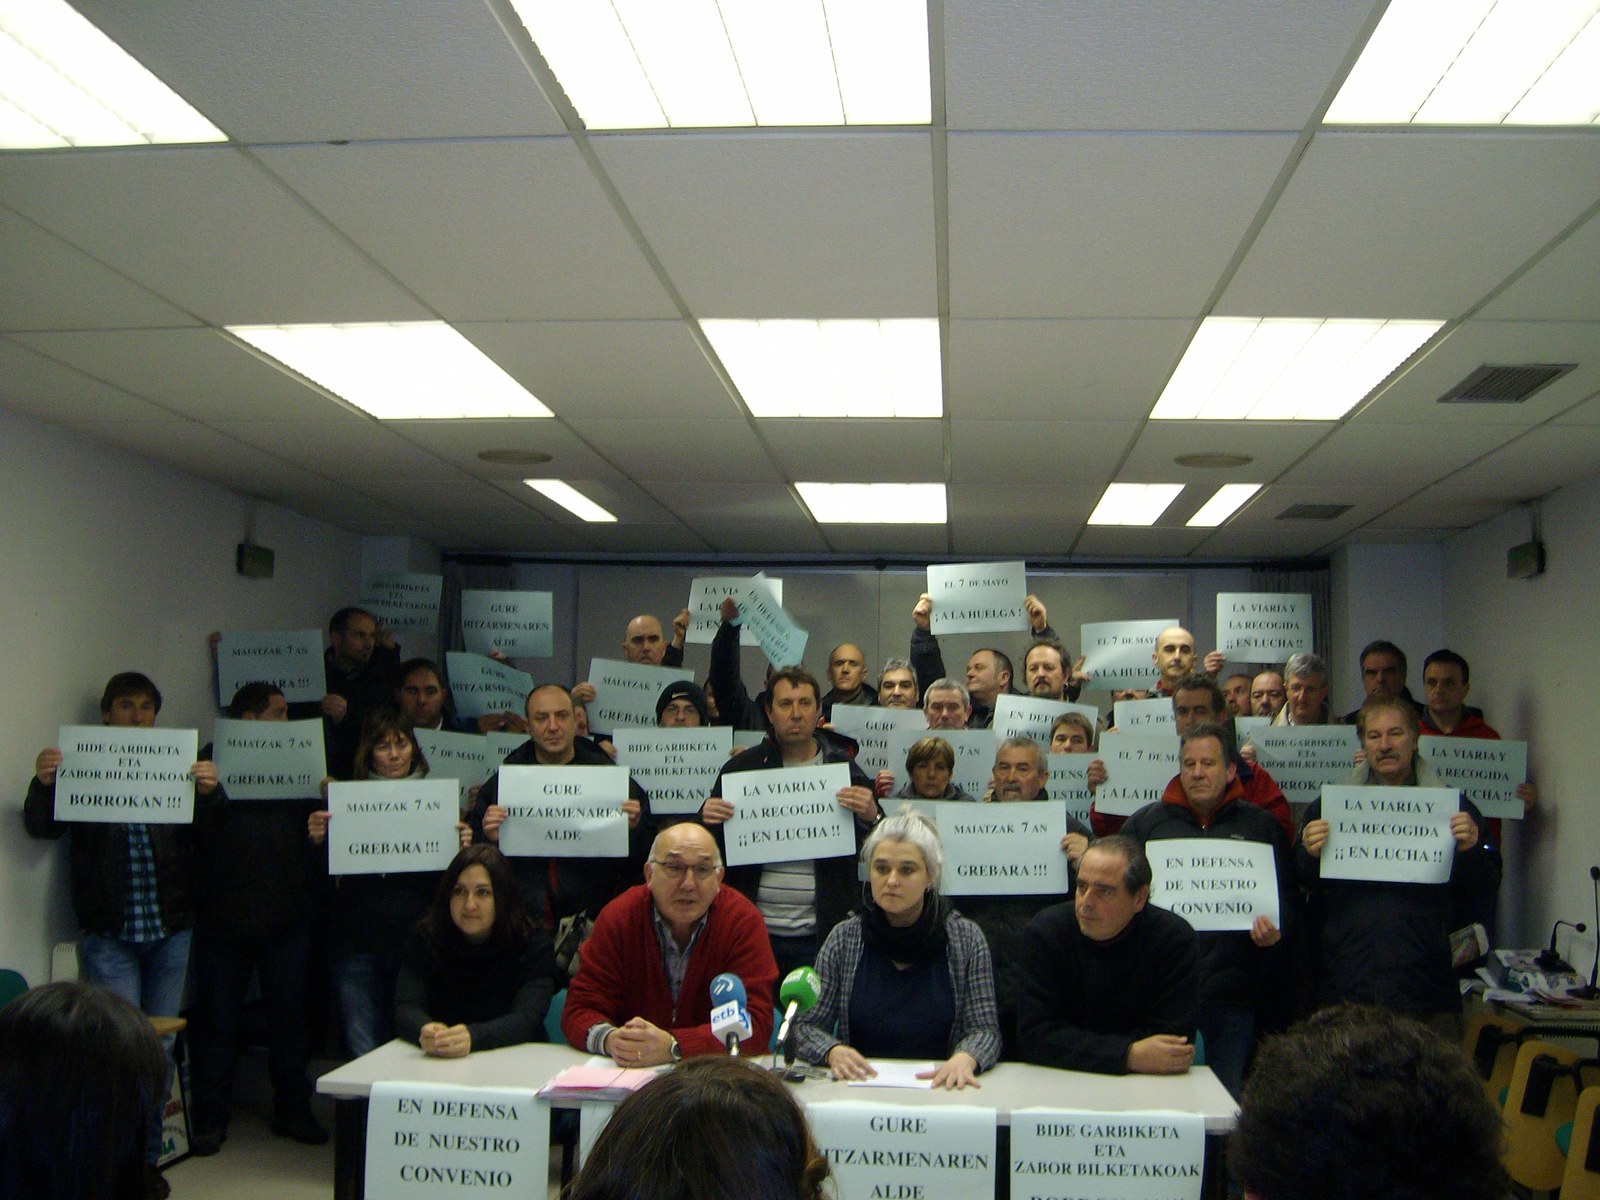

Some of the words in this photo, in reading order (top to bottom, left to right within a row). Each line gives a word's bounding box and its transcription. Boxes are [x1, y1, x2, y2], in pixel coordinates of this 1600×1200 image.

[959, 579, 964, 588] 7
[968, 580, 980, 588] DE
[982, 578, 1008, 588] MAYO
[704, 586, 717, 595] LA
[490, 604, 519, 614] GURE
[700, 603, 712, 611] LA
[1232, 604, 1246, 612] LA
[1250, 604, 1287, 613] VIARIA
[1290, 604, 1296, 613] Y
[935, 614, 938, 622] ¡
[940, 612, 948, 620] A
[951, 610, 966, 620] LA
[968, 608, 1016, 620] HUELGA
[1018, 608, 1022, 617] !
[1229, 621, 1242, 630] LA
[1244, 621, 1300, 630] RECOGIDA
[492, 639, 518, 647] ALDE
[1097, 638, 1108, 646] EL
[1112, 636, 1118, 645] 7
[1122, 637, 1134, 645] DE
[1226, 640, 1233, 650] ¡¡
[1236, 639, 1251, 648] EN
[1254, 640, 1294, 648] LUCHA
[1296, 640, 1303, 648] !!
[232, 648, 281, 656] MAIATZAK
[286, 646, 293, 655] 7
[296, 647, 308, 656] AN
[1092, 668, 1100, 678] A
[1102, 668, 1118, 678] LA
[1120, 667, 1160, 678] HUELG
[602, 676, 650, 691] MAIATZAK
[1010, 710, 1024, 720] EN
[1130, 717, 1142, 726] EL
[1145, 714, 1151, 724] 7
[227, 738, 282, 748] MAIATZAK
[290, 738, 296, 748] 7
[300, 739, 313, 748] AN
[628, 744, 654, 752] BIDE
[655, 742, 718, 752] GARBIKETA
[1265, 740, 1286, 748] BIDE
[1289, 740, 1348, 748] GARBIKETA
[77, 743, 106, 753] BIDE
[109, 744, 180, 756] GARBIKETA
[430, 746, 436, 756] 7
[440, 749, 454, 758] DE
[456, 752, 484, 761] MAYO
[958, 746, 964, 756] 7
[966, 748, 980, 756] AN
[1118, 752, 1132, 760] EL
[1136, 750, 1144, 760] 7
[1298, 750, 1316, 758] ETA
[1432, 748, 1446, 758] LA
[1454, 748, 1495, 760] VIARIA
[1498, 752, 1506, 762] Y
[118, 758, 141, 767] ETA
[664, 755, 684, 764] ETA
[864, 758, 888, 768] ALD
[60, 768, 102, 780] ZABOR
[630, 766, 651, 776] BOR
[1445, 768, 1509, 780] RECOGIDA
[227, 774, 294, 785] GREBARA
[298, 774, 311, 785] !!!
[543, 784, 582, 796] GURE
[646, 788, 705, 800] RROKAN
[743, 786, 760, 797] LA
[767, 781, 816, 794] VIARIA
[818, 780, 828, 791] Y
[1102, 788, 1106, 799] ¡
[1110, 788, 1118, 798] A
[1122, 788, 1140, 799] LA
[70, 794, 162, 808] BORROKAN
[166, 796, 182, 808] !!!
[1464, 788, 1500, 800] UCHA
[1504, 792, 1512, 802] !!
[346, 801, 408, 812] MAIATZAK
[414, 799, 422, 810] 7
[426, 801, 440, 811] AN
[740, 808, 758, 820] LA
[762, 802, 834, 818] RECOGIDA
[1344, 800, 1362, 810] LA
[1370, 800, 1420, 813] VIARIA
[1425, 802, 1434, 814] Y
[954, 824, 1014, 834] MAIATZAK
[1022, 822, 1028, 833] 7
[1032, 824, 1048, 833] AN
[1339, 822, 1358, 834] LA
[1362, 823, 1439, 838] RECOGIDA
[544, 830, 582, 841] ALDE
[738, 835, 748, 847] ¡¡
[752, 830, 770, 843] EN
[776, 826, 828, 842] LUCHA
[831, 825, 840, 837] !!
[348, 842, 422, 855] GREBARA
[426, 842, 440, 853] !!!
[1334, 848, 1344, 860] ¡¡
[1348, 846, 1369, 858] EN
[1374, 847, 1428, 862] LUCHA
[1433, 850, 1442, 863] !!
[1166, 858, 1184, 868] EN
[1192, 858, 1254, 868] DEFENSA
[957, 864, 1029, 877] GREBARA
[1034, 864, 1047, 876] !!!
[1166, 880, 1183, 891] DE
[1190, 880, 1256, 890] NUESTRO
[1171, 902, 1252, 914] CONVENIO
[712, 1006, 736, 1024] etb
[397, 1098, 422, 1114] EN
[432, 1100, 518, 1120] DEFENSA
[870, 1116, 928, 1134] GURE
[1036, 1124, 1076, 1138] BIDE
[1080, 1124, 1180, 1140] GARBIKETA
[394, 1131, 420, 1148] DE
[428, 1133, 520, 1154] NUESTRO
[1094, 1144, 1126, 1158] ETA
[1014, 1160, 1072, 1176] ZABOR
[1076, 1162, 1200, 1178] BILKETAKOAK
[400, 1164, 512, 1188] CONVENIO
[870, 1184, 926, 1200] ALDE
